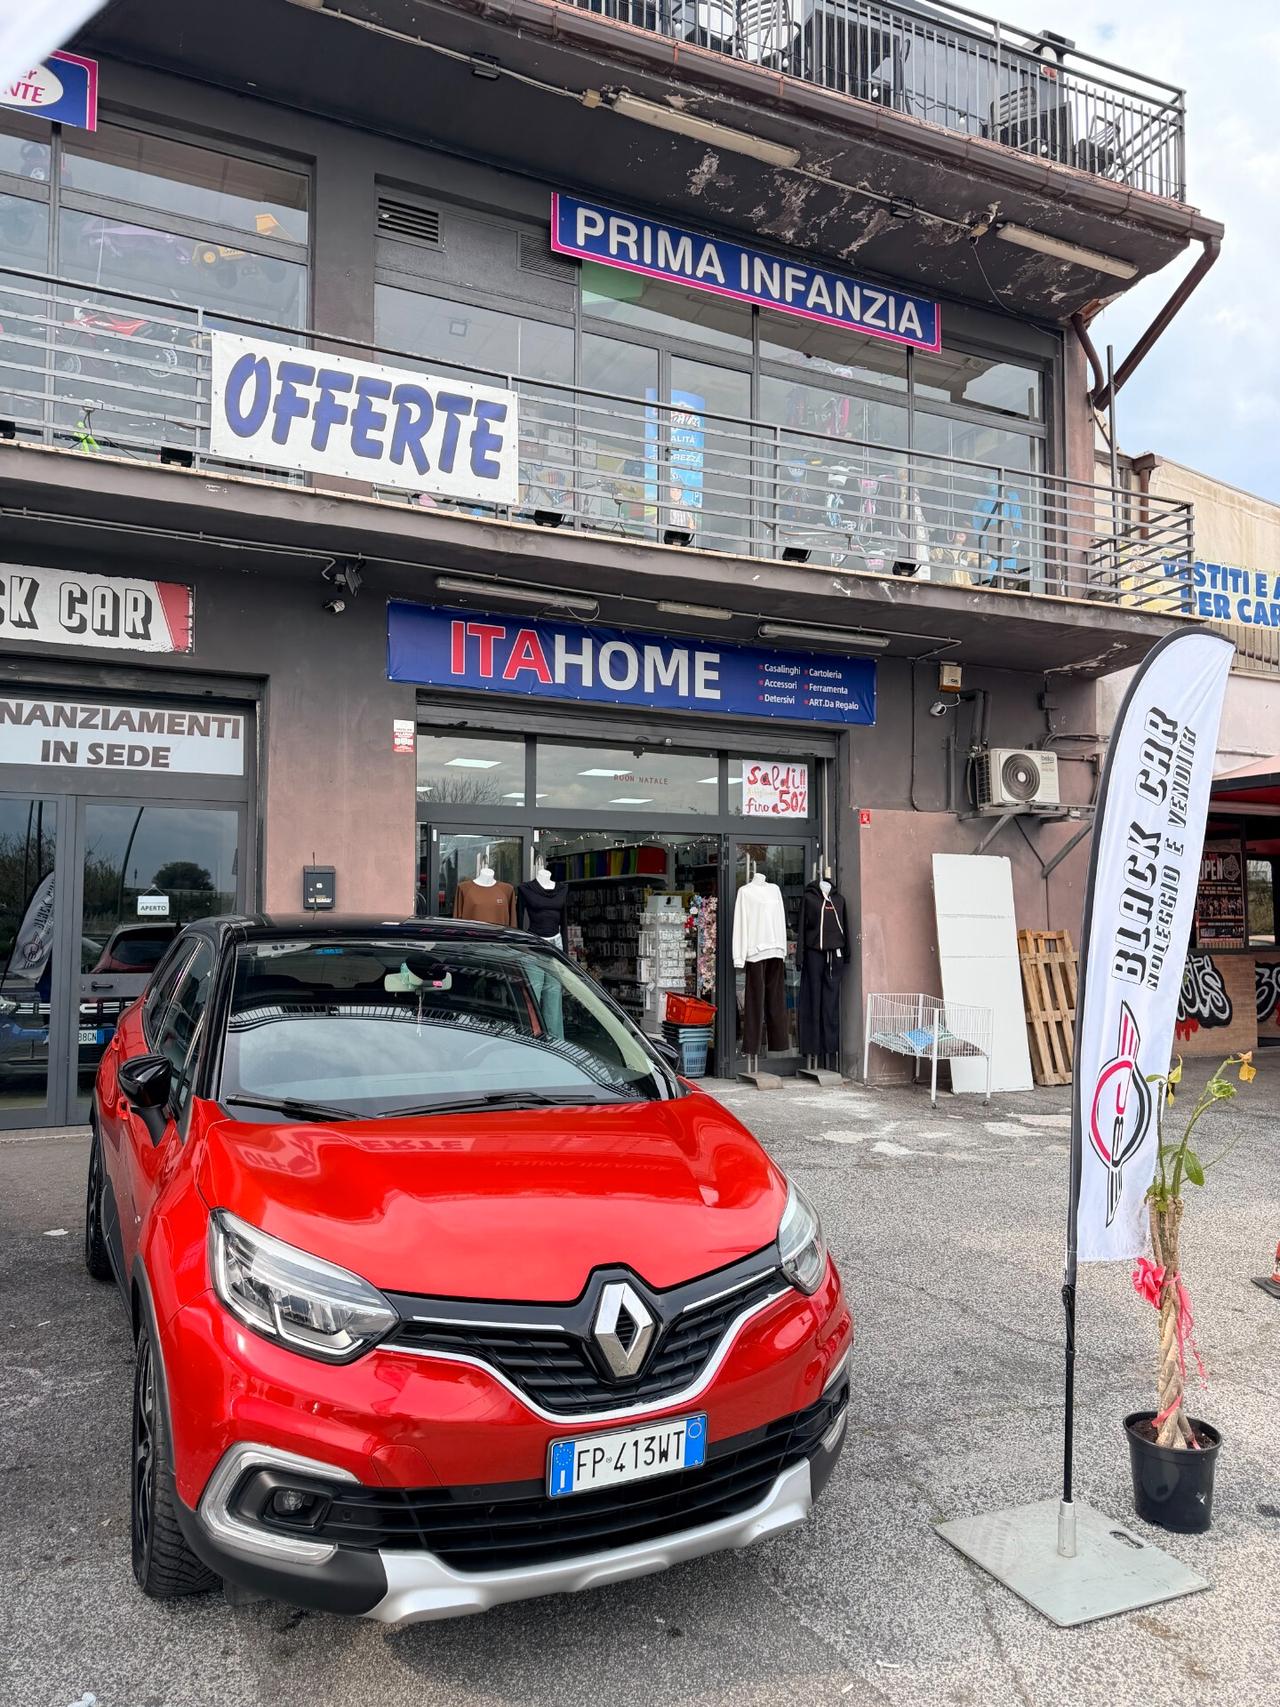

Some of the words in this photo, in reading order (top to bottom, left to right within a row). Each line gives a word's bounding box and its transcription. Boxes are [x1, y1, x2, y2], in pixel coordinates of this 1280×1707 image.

[576, 207, 725, 284] PRIMA
[741, 253, 924, 339] INFANZIA
[224, 353, 508, 480] OFFERTE
[1256, 573, 1268, 598] E
[0, 575, 39, 630] K
[59, 581, 152, 640] CAR
[1237, 598, 1280, 627] CAR
[451, 620, 721, 699] ITAHOME
[764, 664, 801, 676] Casalinghi
[764, 679, 798, 690] Accessori
[809, 668, 842, 679] Cartoleria
[764, 694, 795, 704] Detersivi
[809, 683, 848, 695] Ferramenta
[835, 700, 859, 711] Regalo
[41, 740, 78, 764] IN
[87, 742, 171, 768] SEDE
[1135, 707, 1178, 806] CAR
[638, 776, 669, 785] NATALE
[1167, 726, 1197, 828] VENDITA
[745, 797, 770, 814] fino
[778, 790, 806, 813] 50%
[1163, 837, 1184, 857] E
[1111, 821, 1161, 986] BLACK
[1146, 865, 1180, 990] NOLEGGIO
